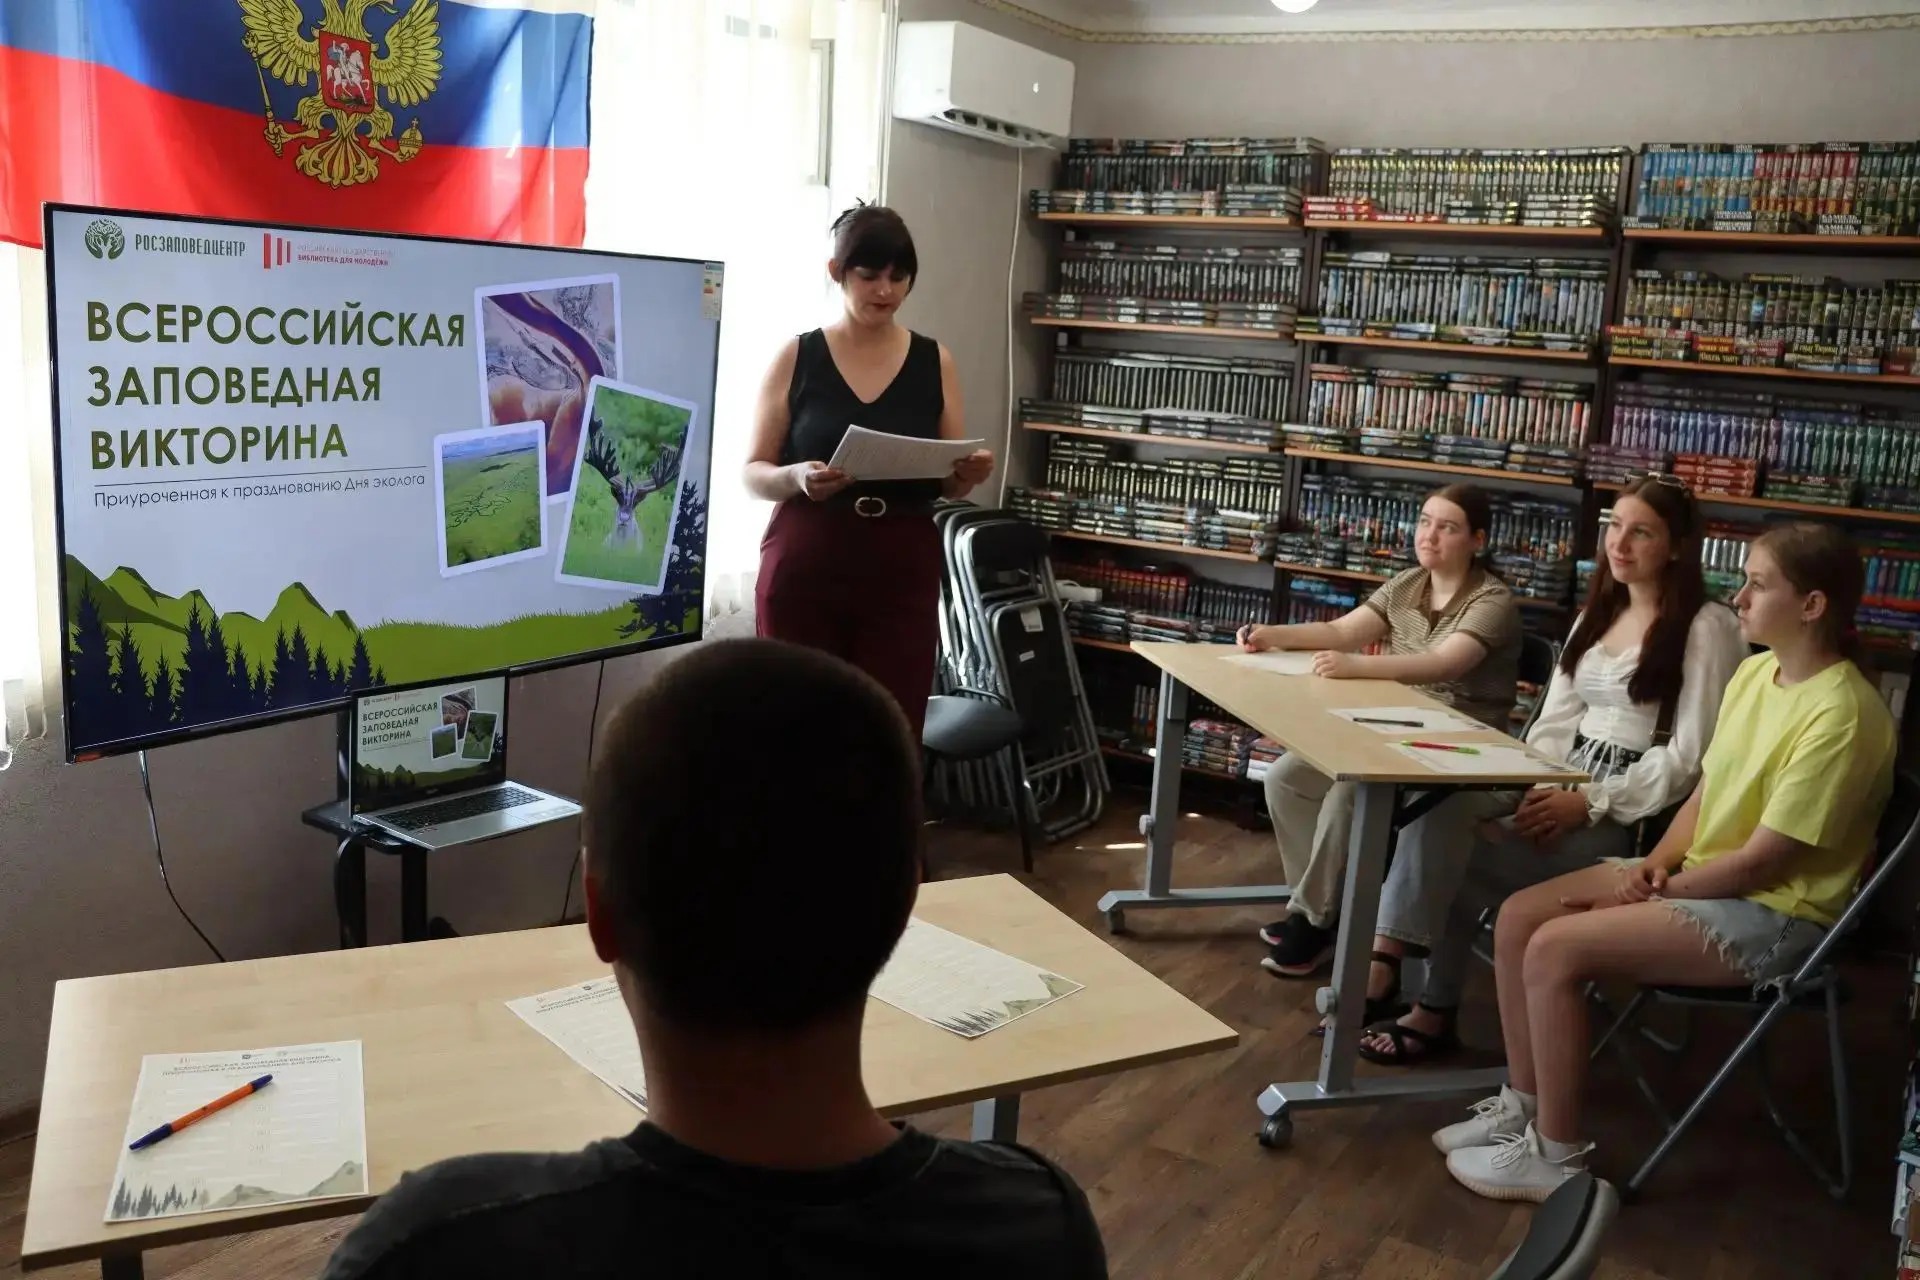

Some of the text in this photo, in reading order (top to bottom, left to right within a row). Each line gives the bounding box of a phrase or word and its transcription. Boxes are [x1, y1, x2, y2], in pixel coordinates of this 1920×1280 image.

[135, 233, 246, 257] РОСЗАПОВЕДЦЕНТР
[87, 301, 465, 347] ВСЕРОССИЙСКАЯ
[87, 365, 381, 408] ЗАПОВЕДНАЯ
[91, 423, 348, 470] ВИКТОРИНА
[94, 475, 425, 509] Приуроченная к празднованию Дня эколога
[362, 702, 438, 721] ВСЕРОССИЙСКАЯ
[362, 717, 419, 734] ЗАПОВЕДНАЯ
[362, 730, 412, 746] ВИКТОРИНА
